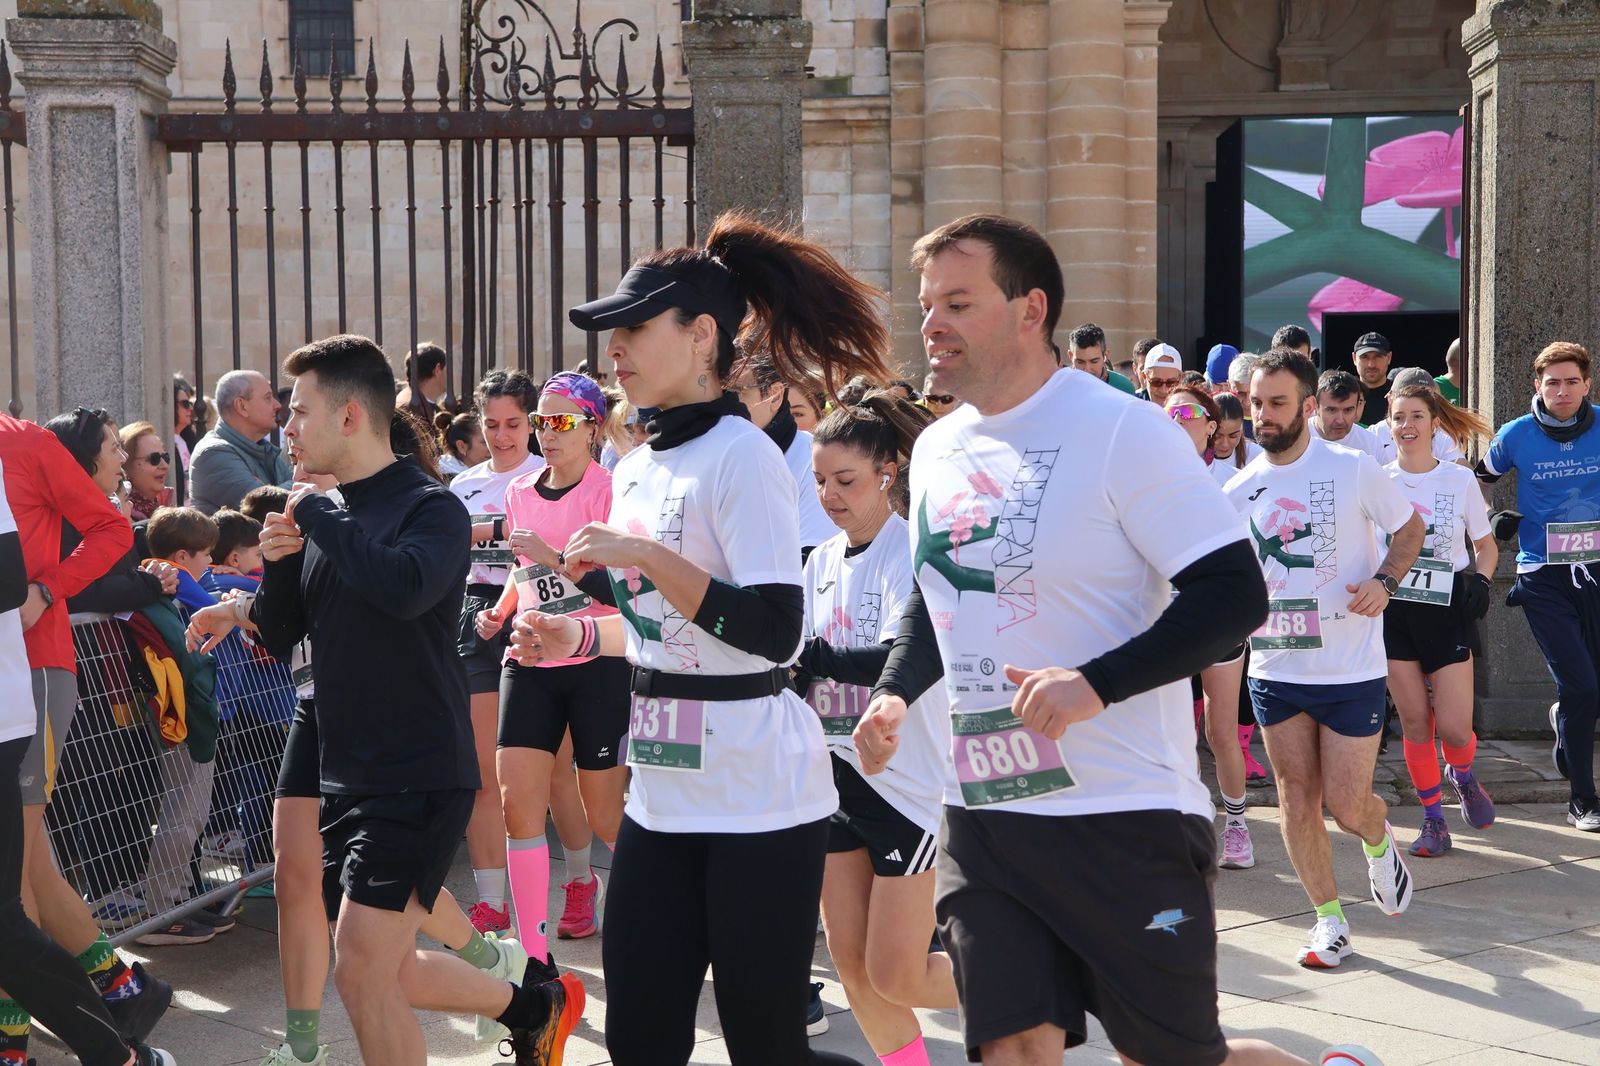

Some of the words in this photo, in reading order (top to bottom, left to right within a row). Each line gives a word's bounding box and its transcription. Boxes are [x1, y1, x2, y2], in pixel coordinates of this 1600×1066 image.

[1531, 466, 1600, 480] AMIZAD
[1534, 459, 1582, 470] TRAIL
[1584, 455, 1600, 464] D
[1558, 533, 1594, 552] 725
[536, 575, 565, 603] 85
[1410, 569, 1432, 589] 71
[814, 681, 859, 714] 611
[632, 698, 678, 740] 531
[965, 731, 1040, 778] 680
